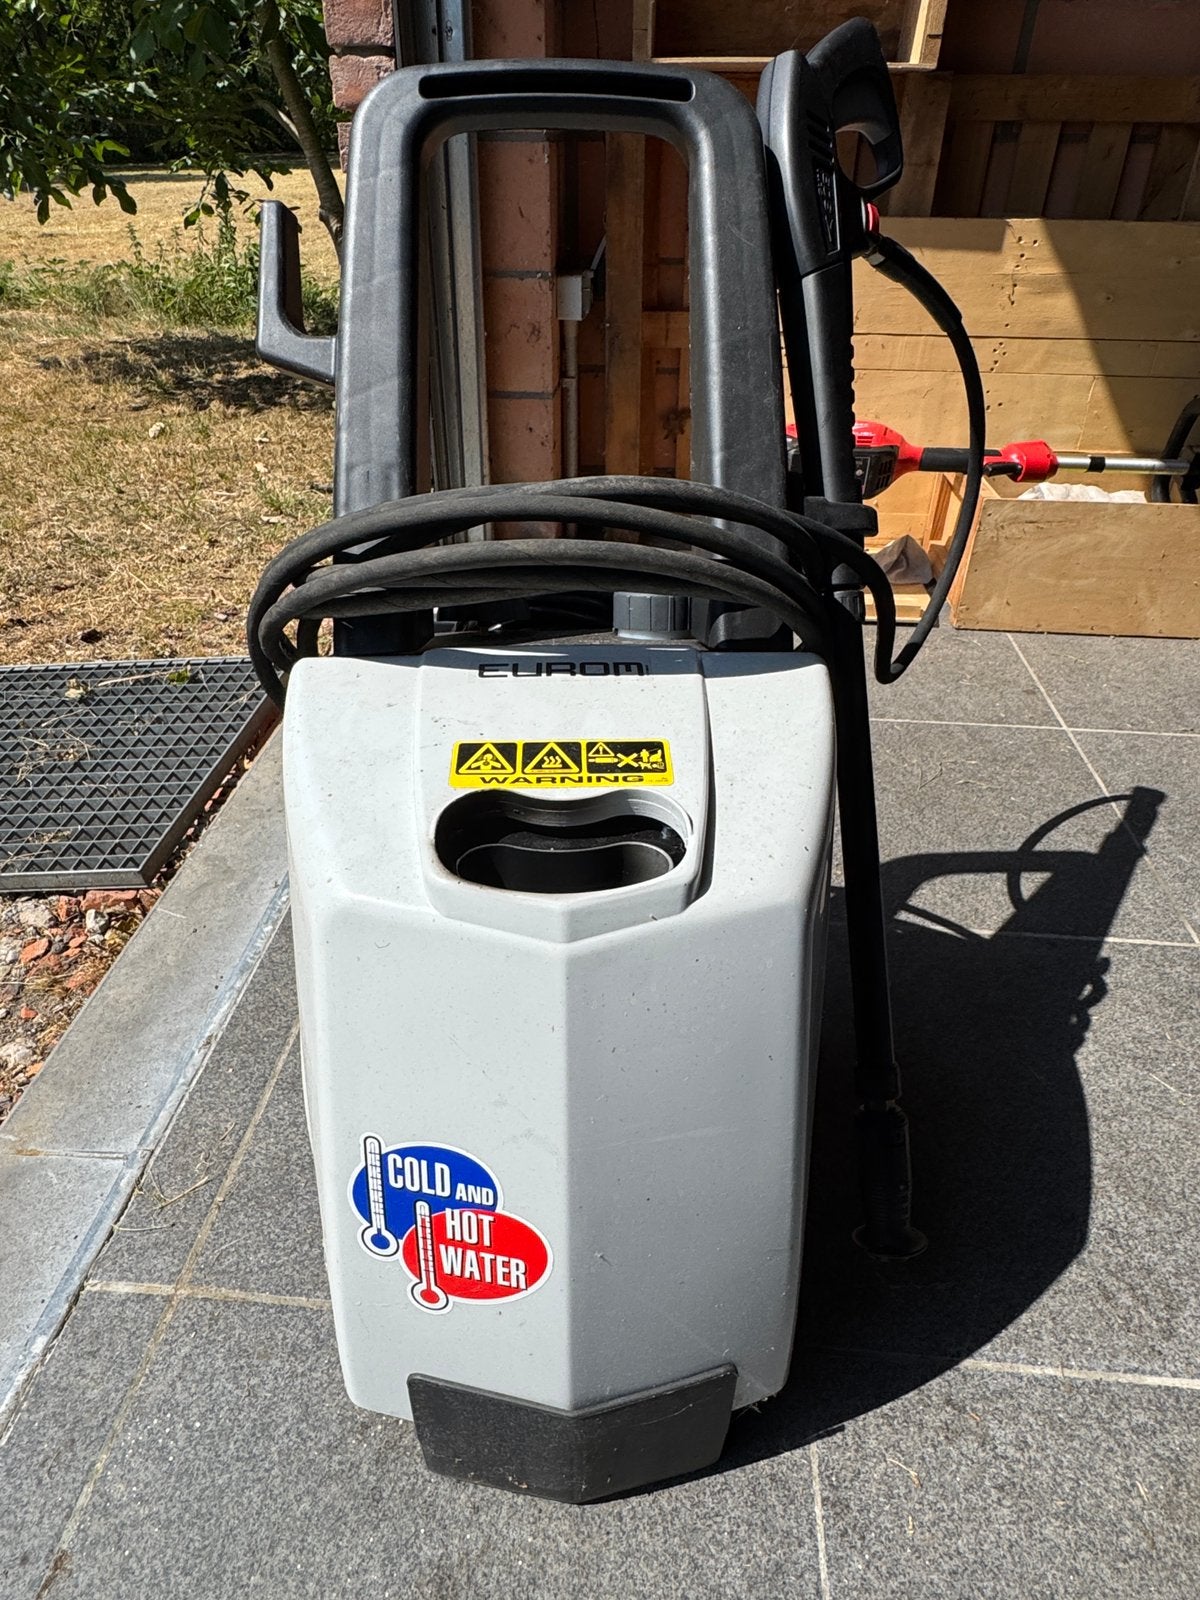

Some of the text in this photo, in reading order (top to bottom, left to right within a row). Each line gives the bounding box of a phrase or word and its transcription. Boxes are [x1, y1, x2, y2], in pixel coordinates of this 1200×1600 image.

[478, 662, 644, 677] EUROM
[480, 775, 644, 784] WARNING
[387, 1153, 495, 1206] COLD AND
[445, 1208, 495, 1247] HOT
[439, 1244, 528, 1290] WATER
